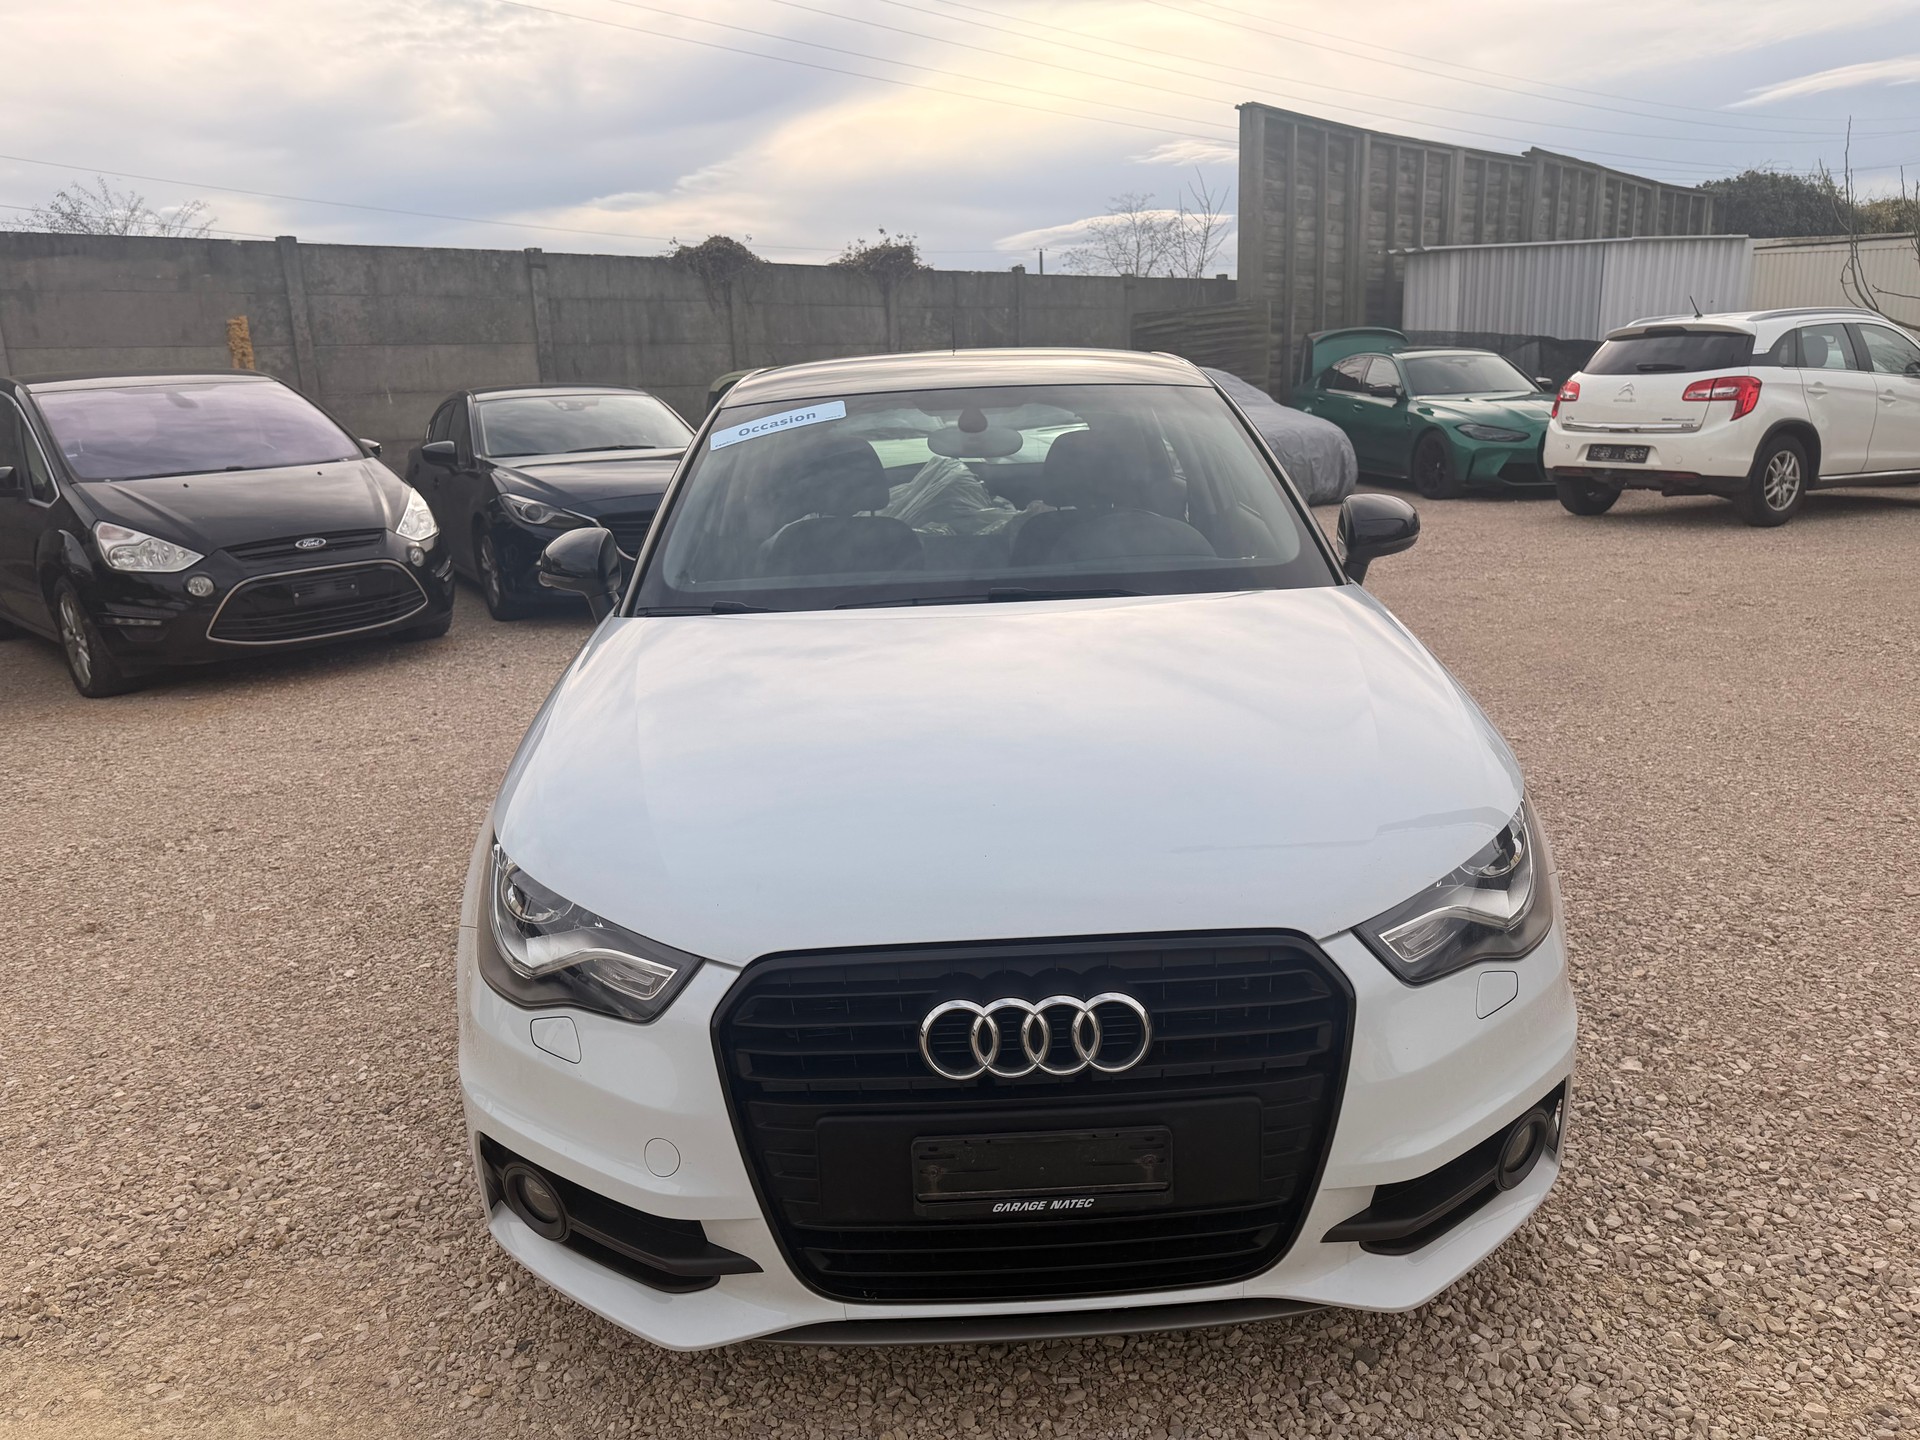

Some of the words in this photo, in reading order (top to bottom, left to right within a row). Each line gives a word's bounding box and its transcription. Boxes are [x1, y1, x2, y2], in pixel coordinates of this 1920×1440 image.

[738, 412, 816, 436] Occasion
[992, 1201, 1047, 1212] GARAGE
[1050, 1198, 1095, 1209] NATEC
